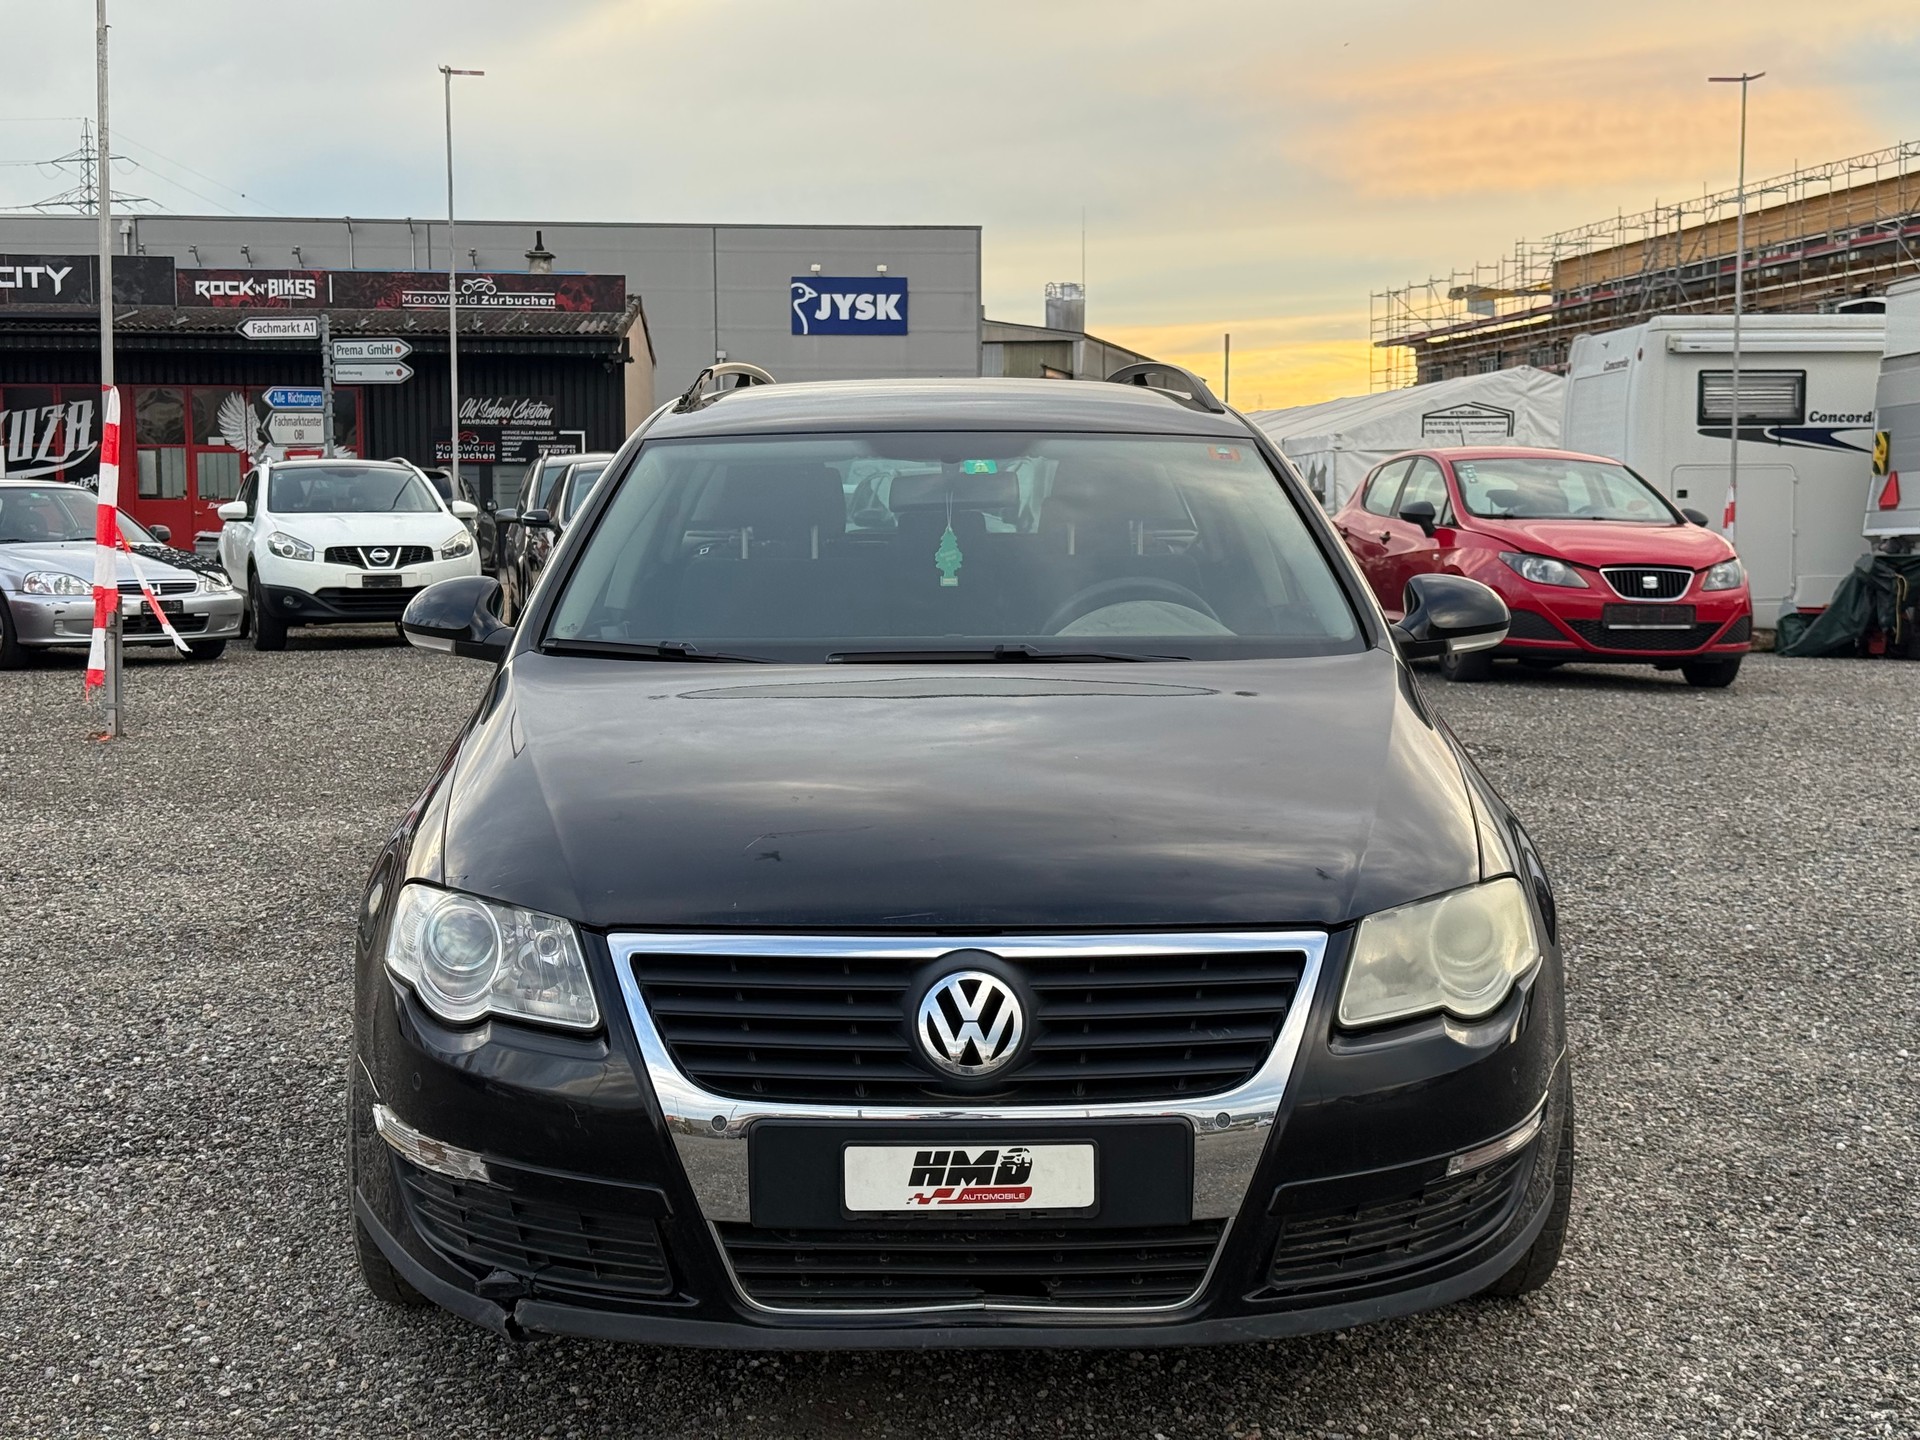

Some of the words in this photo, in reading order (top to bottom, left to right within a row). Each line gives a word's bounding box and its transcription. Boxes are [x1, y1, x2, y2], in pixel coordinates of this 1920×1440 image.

[402, 294, 478, 304] MotoWrld
[481, 295, 556, 306] Zurbuchen
[814, 293, 902, 320] JYSK
[252, 322, 301, 334] Fachmarkt
[303, 322, 315, 333] A1
[336, 344, 363, 356] Prema
[367, 344, 394, 355] GmbH
[273, 391, 286, 404] Alle
[287, 391, 322, 407] Richtungen
[459, 397, 482, 419] Old
[478, 397, 518, 419] School
[513, 398, 553, 420] Custom
[274, 416, 322, 427] Fachmarktcenter
[1808, 410, 1875, 424] Concord
[294, 430, 305, 441] OBI
[435, 444, 496, 452] MooWorld
[962, 1192, 1026, 1201] AUTOMOBILE
